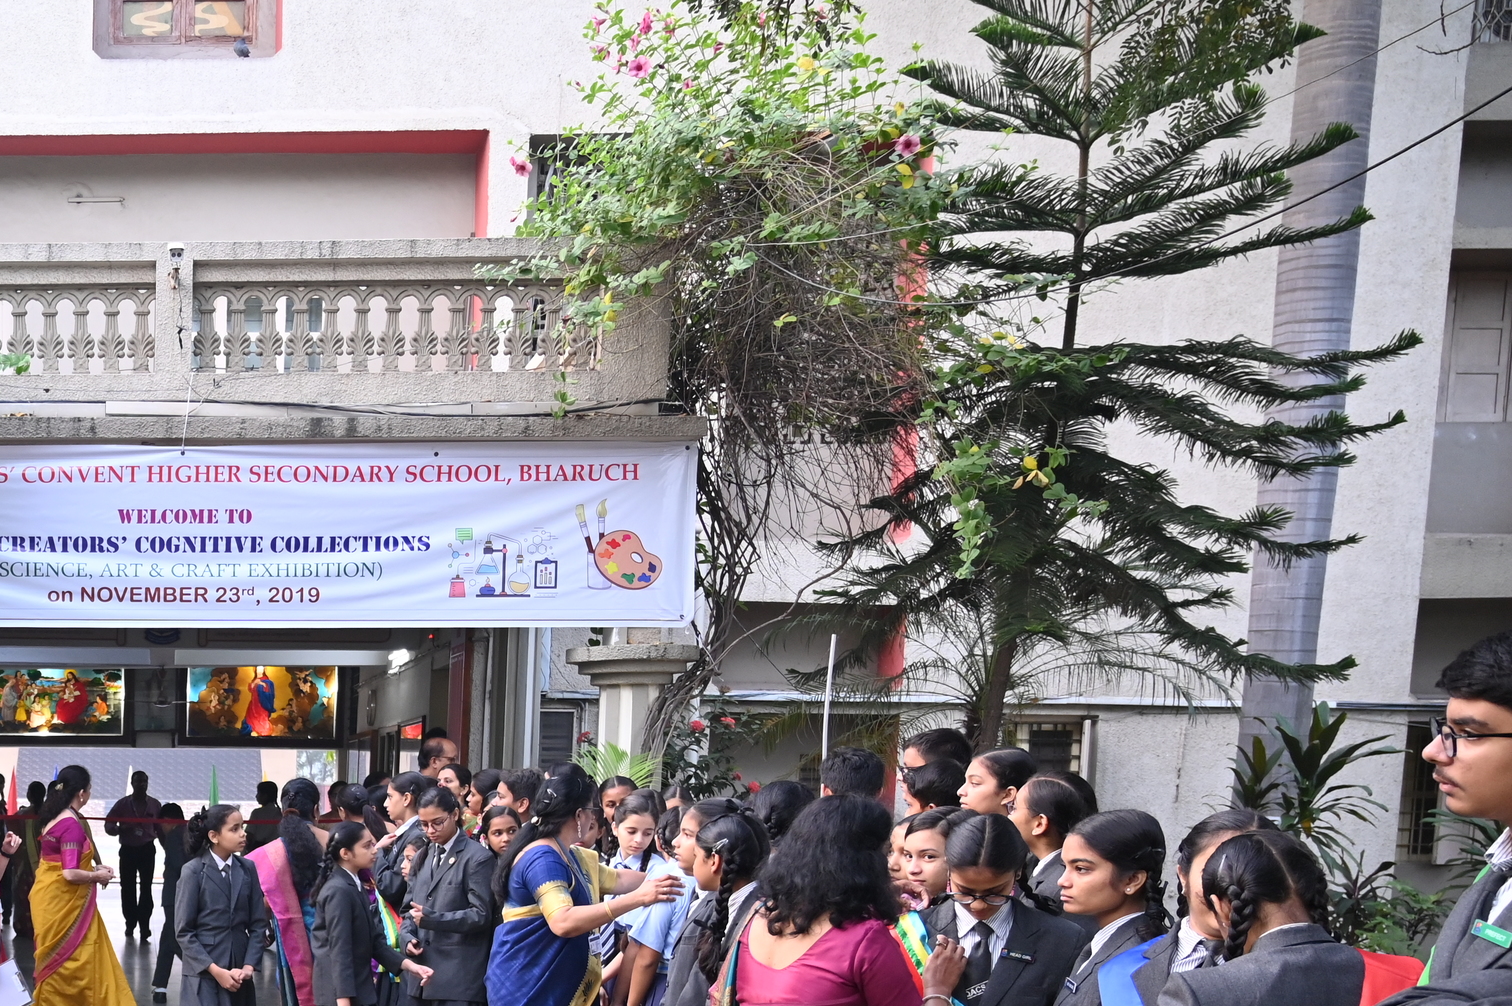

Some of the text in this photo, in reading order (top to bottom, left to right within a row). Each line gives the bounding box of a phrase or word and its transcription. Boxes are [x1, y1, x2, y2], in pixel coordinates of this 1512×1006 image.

[21, 465, 141, 484] CONVENT
[146, 464, 243, 483] HIGHER
[248, 464, 400, 483] SECONDARY
[404, 464, 512, 486] SCHOOL,
[518, 463, 640, 482] BHARUCH
[117, 508, 253, 525] WELCOME TO
[134, 535, 264, 554] COGNITIVE
[269, 535, 431, 553] COLLECTIONS
[99, 563, 143, 578] ART
[148, 563, 165, 578] &
[171, 562, 240, 578] CRAFT
[247, 561, 383, 581] EXHIBITION)
[47, 590, 73, 603] on
[80, 586, 208, 603] NOVEMBER
[268, 587, 320, 603] 2019
